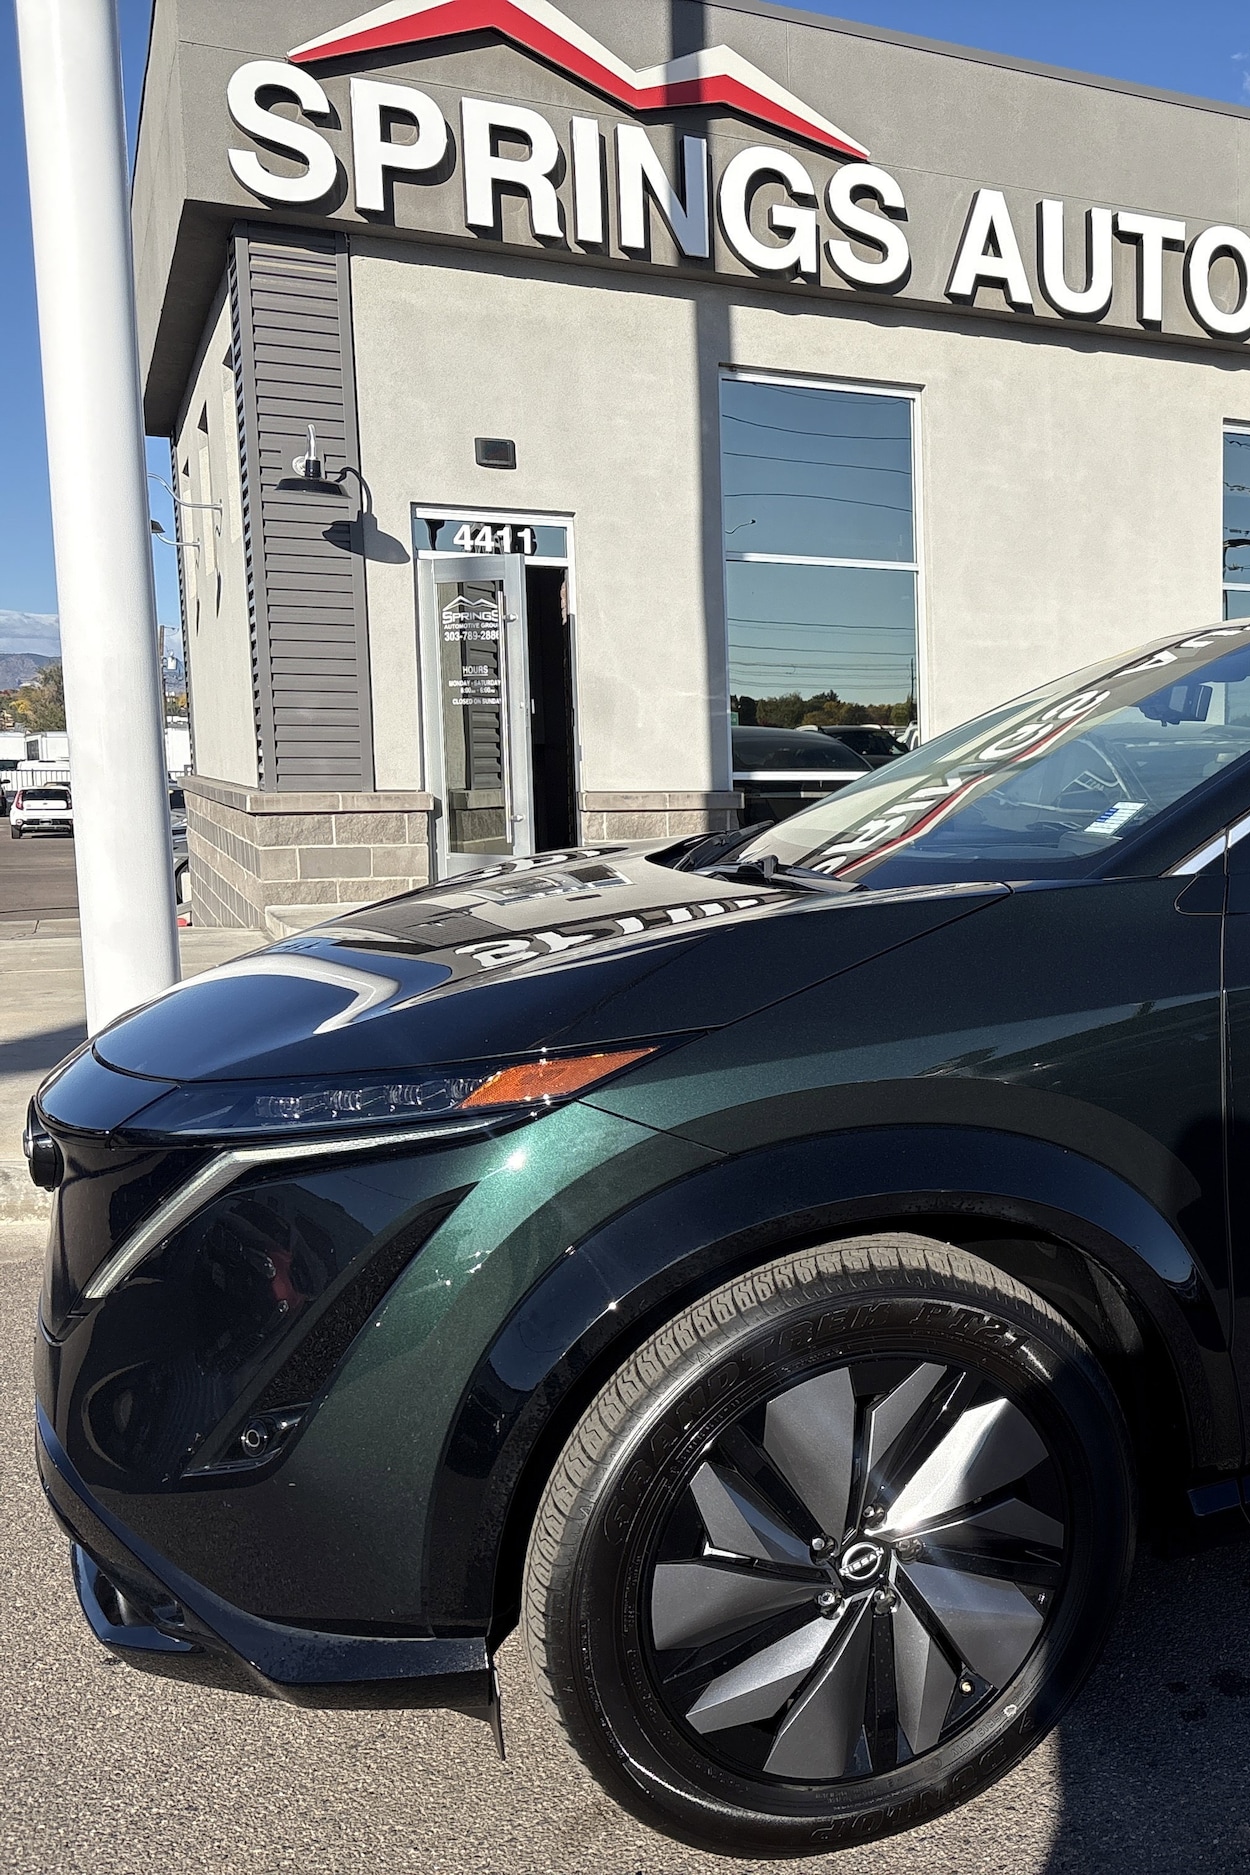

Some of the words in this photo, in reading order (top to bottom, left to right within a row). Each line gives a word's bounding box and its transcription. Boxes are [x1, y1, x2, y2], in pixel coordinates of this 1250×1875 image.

[226, 59, 909, 285] SPRINGS
[453, 523, 532, 555] 4411
[442, 609, 499, 625] SPRINGS
[443, 622, 480, 630] AUTOMOTIVE
[462, 665, 489, 674] HOURS
[839, 1546, 885, 1577] NISSAN
[810, 1737, 1008, 1843] DUNLOP
